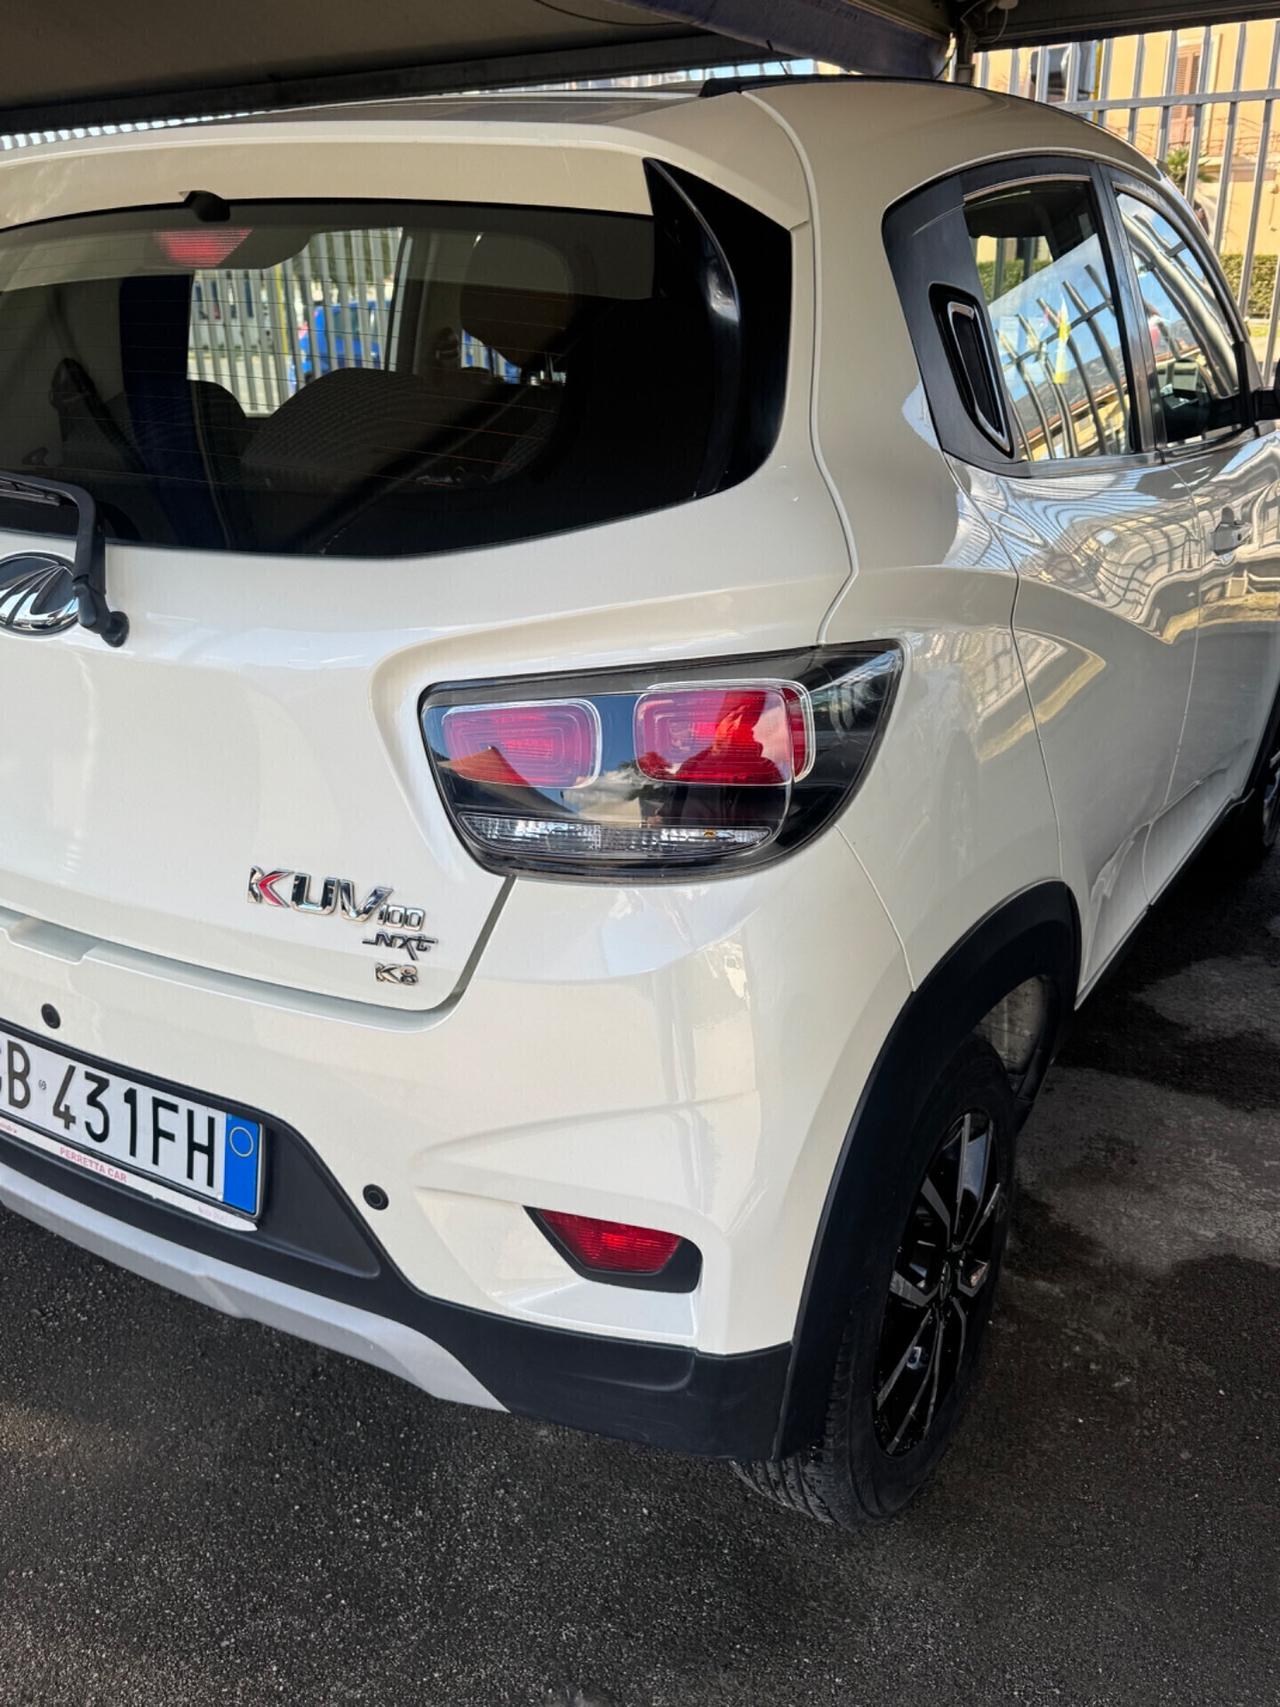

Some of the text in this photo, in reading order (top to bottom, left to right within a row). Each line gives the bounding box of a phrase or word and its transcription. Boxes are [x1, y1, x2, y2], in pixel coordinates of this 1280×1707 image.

[375, 962, 418, 985] K8
[0, 1039, 31, 1109] B
[60, 1147, 127, 1183] PERRETTA CAR
